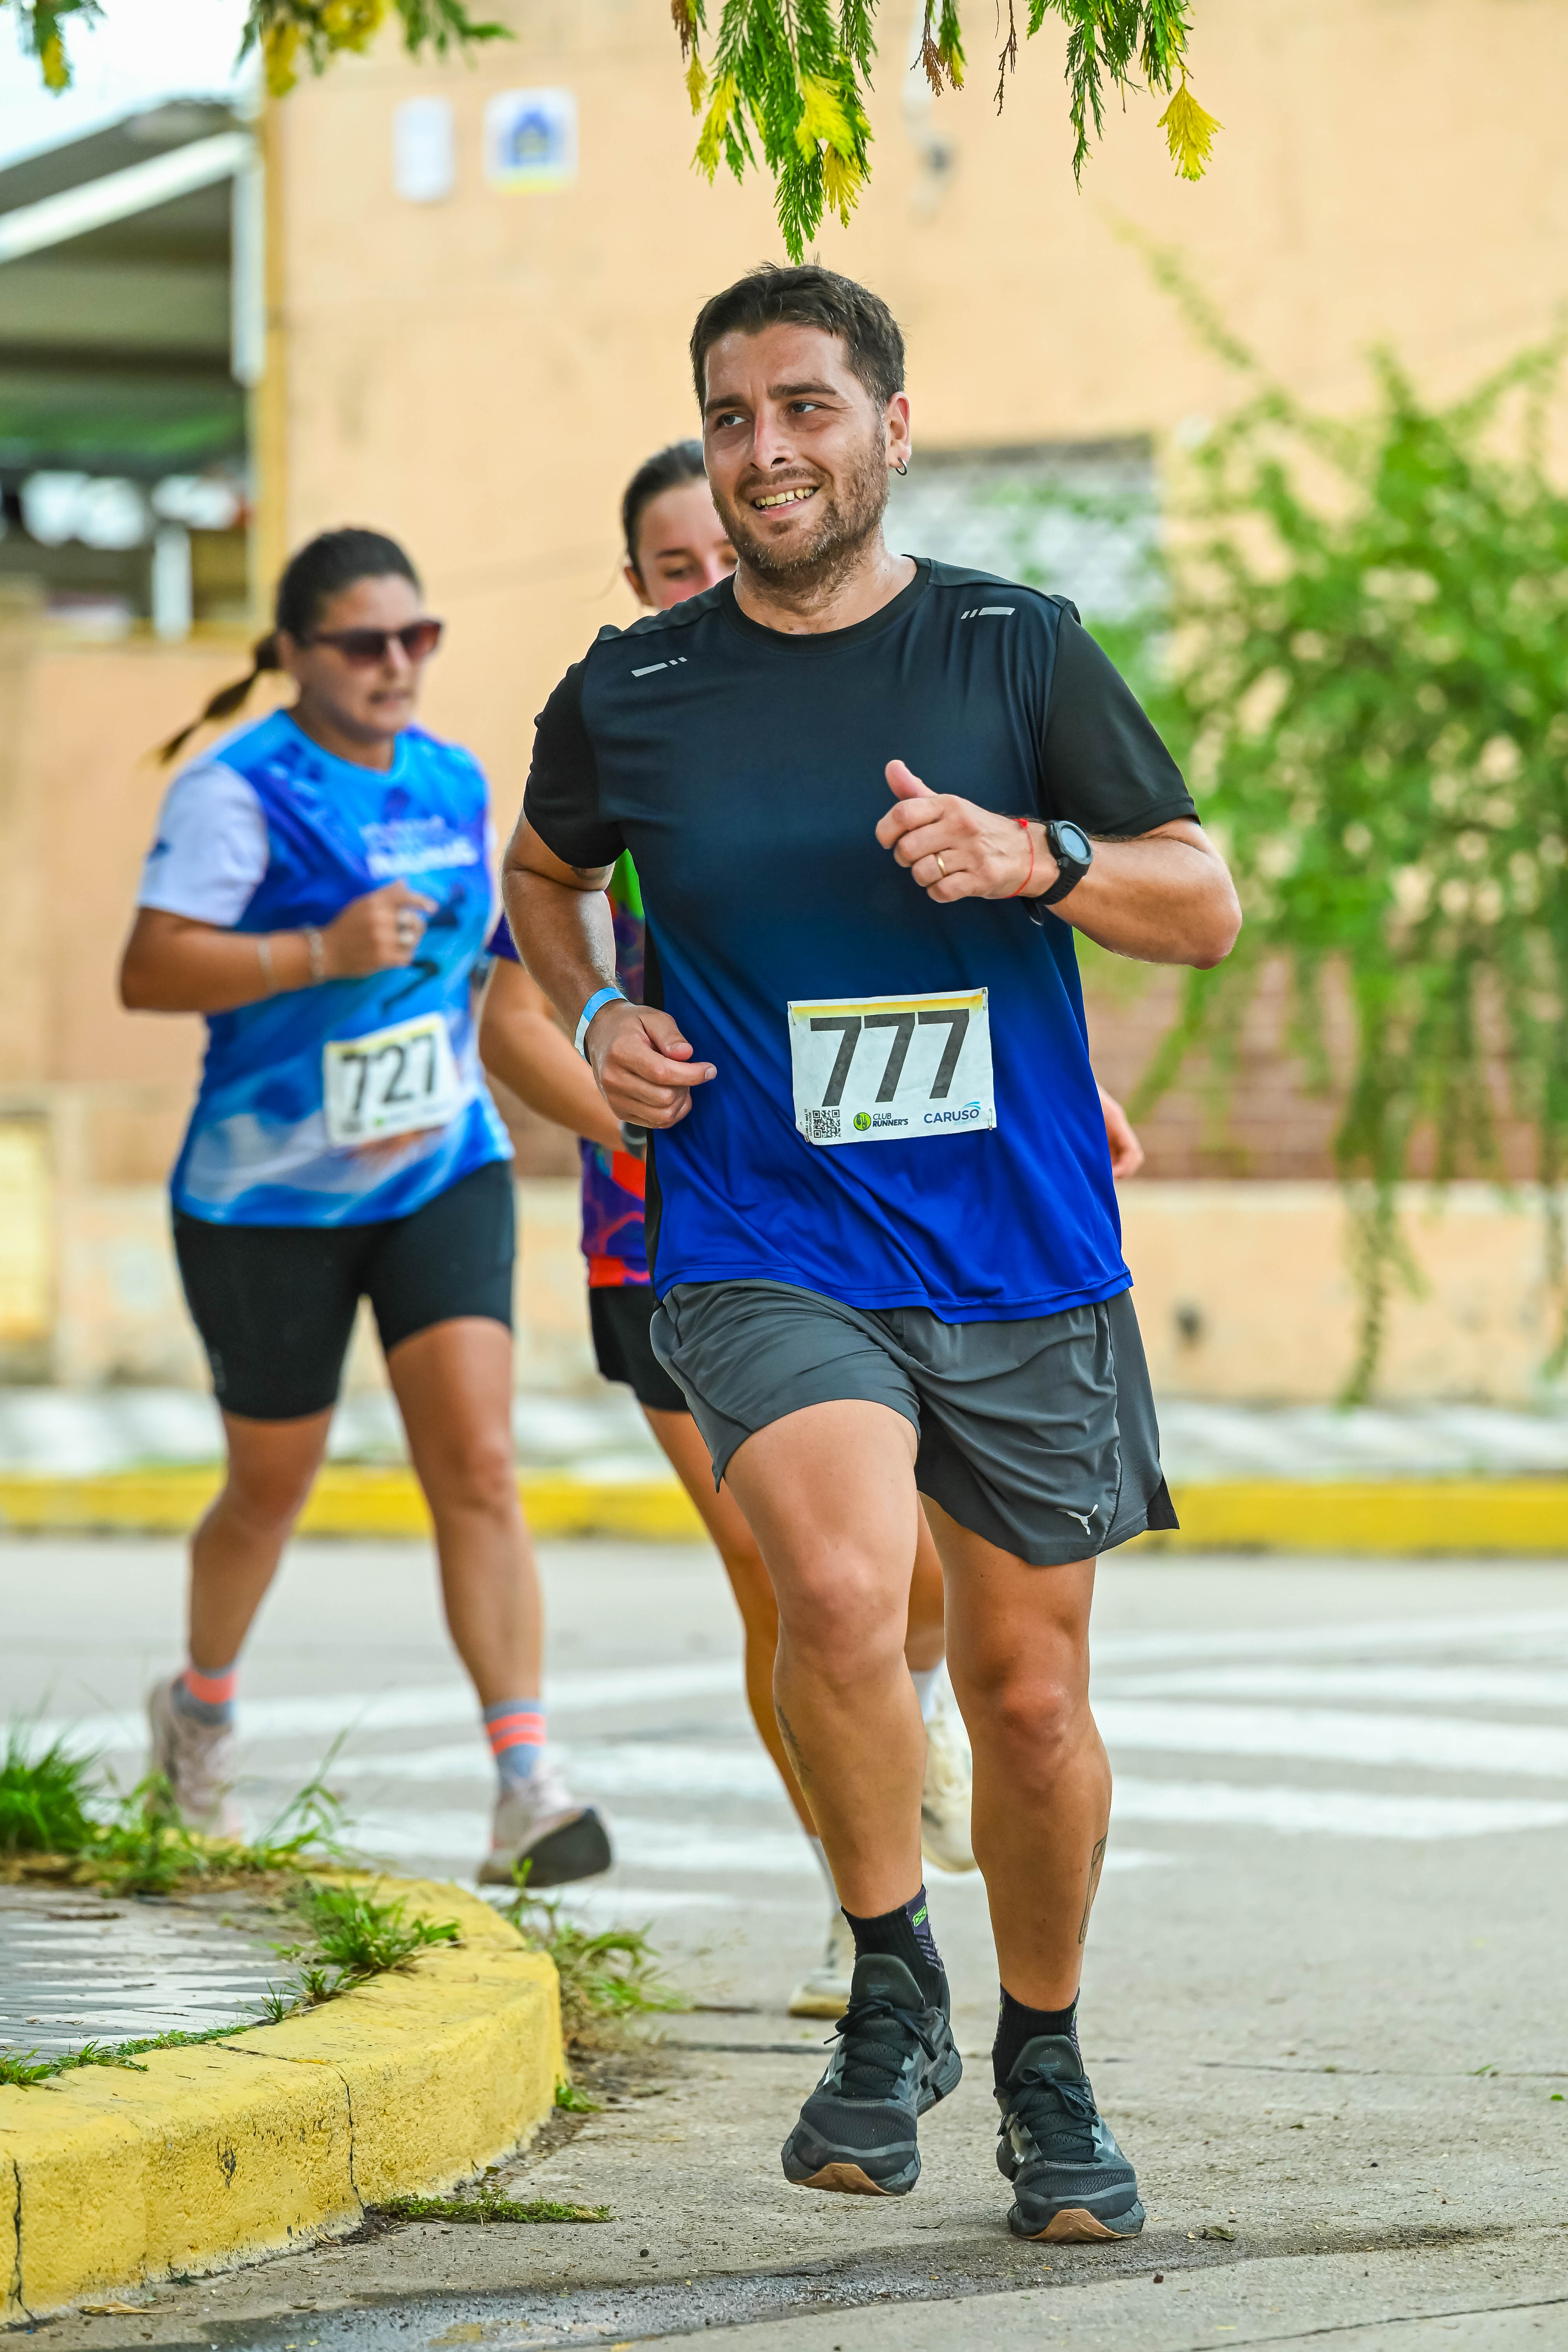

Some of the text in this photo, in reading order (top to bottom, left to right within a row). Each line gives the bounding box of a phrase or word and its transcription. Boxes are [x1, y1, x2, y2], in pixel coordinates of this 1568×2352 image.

[341, 1033, 435, 1112] 727
[810, 1008, 969, 1107] 777
[872, 1118, 908, 1127] RUNNER'S
[924, 1109, 979, 1124] CARUSO
